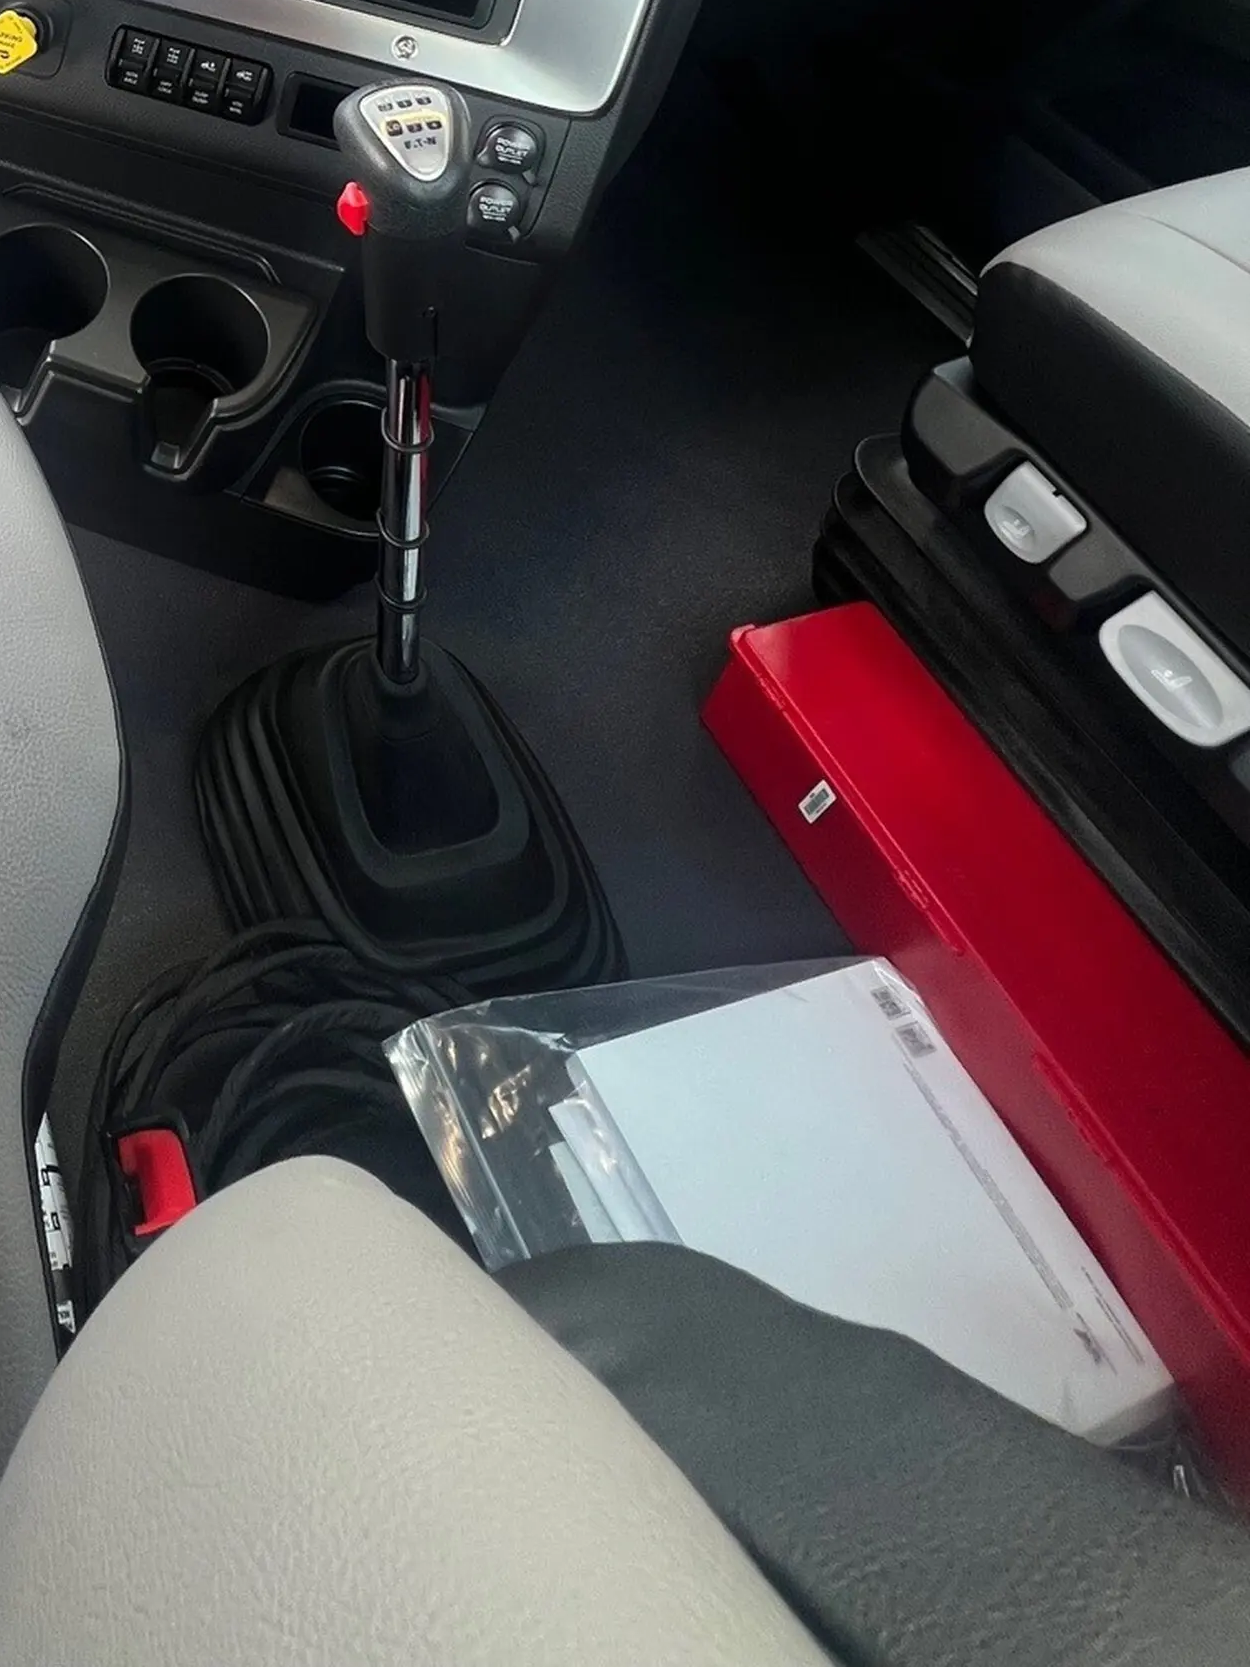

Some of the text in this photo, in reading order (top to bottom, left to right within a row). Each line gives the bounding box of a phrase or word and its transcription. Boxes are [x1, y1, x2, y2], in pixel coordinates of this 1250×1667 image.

[496, 137, 530, 151] POWER
[495, 144, 529, 157] OUTLET
[479, 196, 514, 208] POWER
[478, 203, 511, 214] OUTLET
